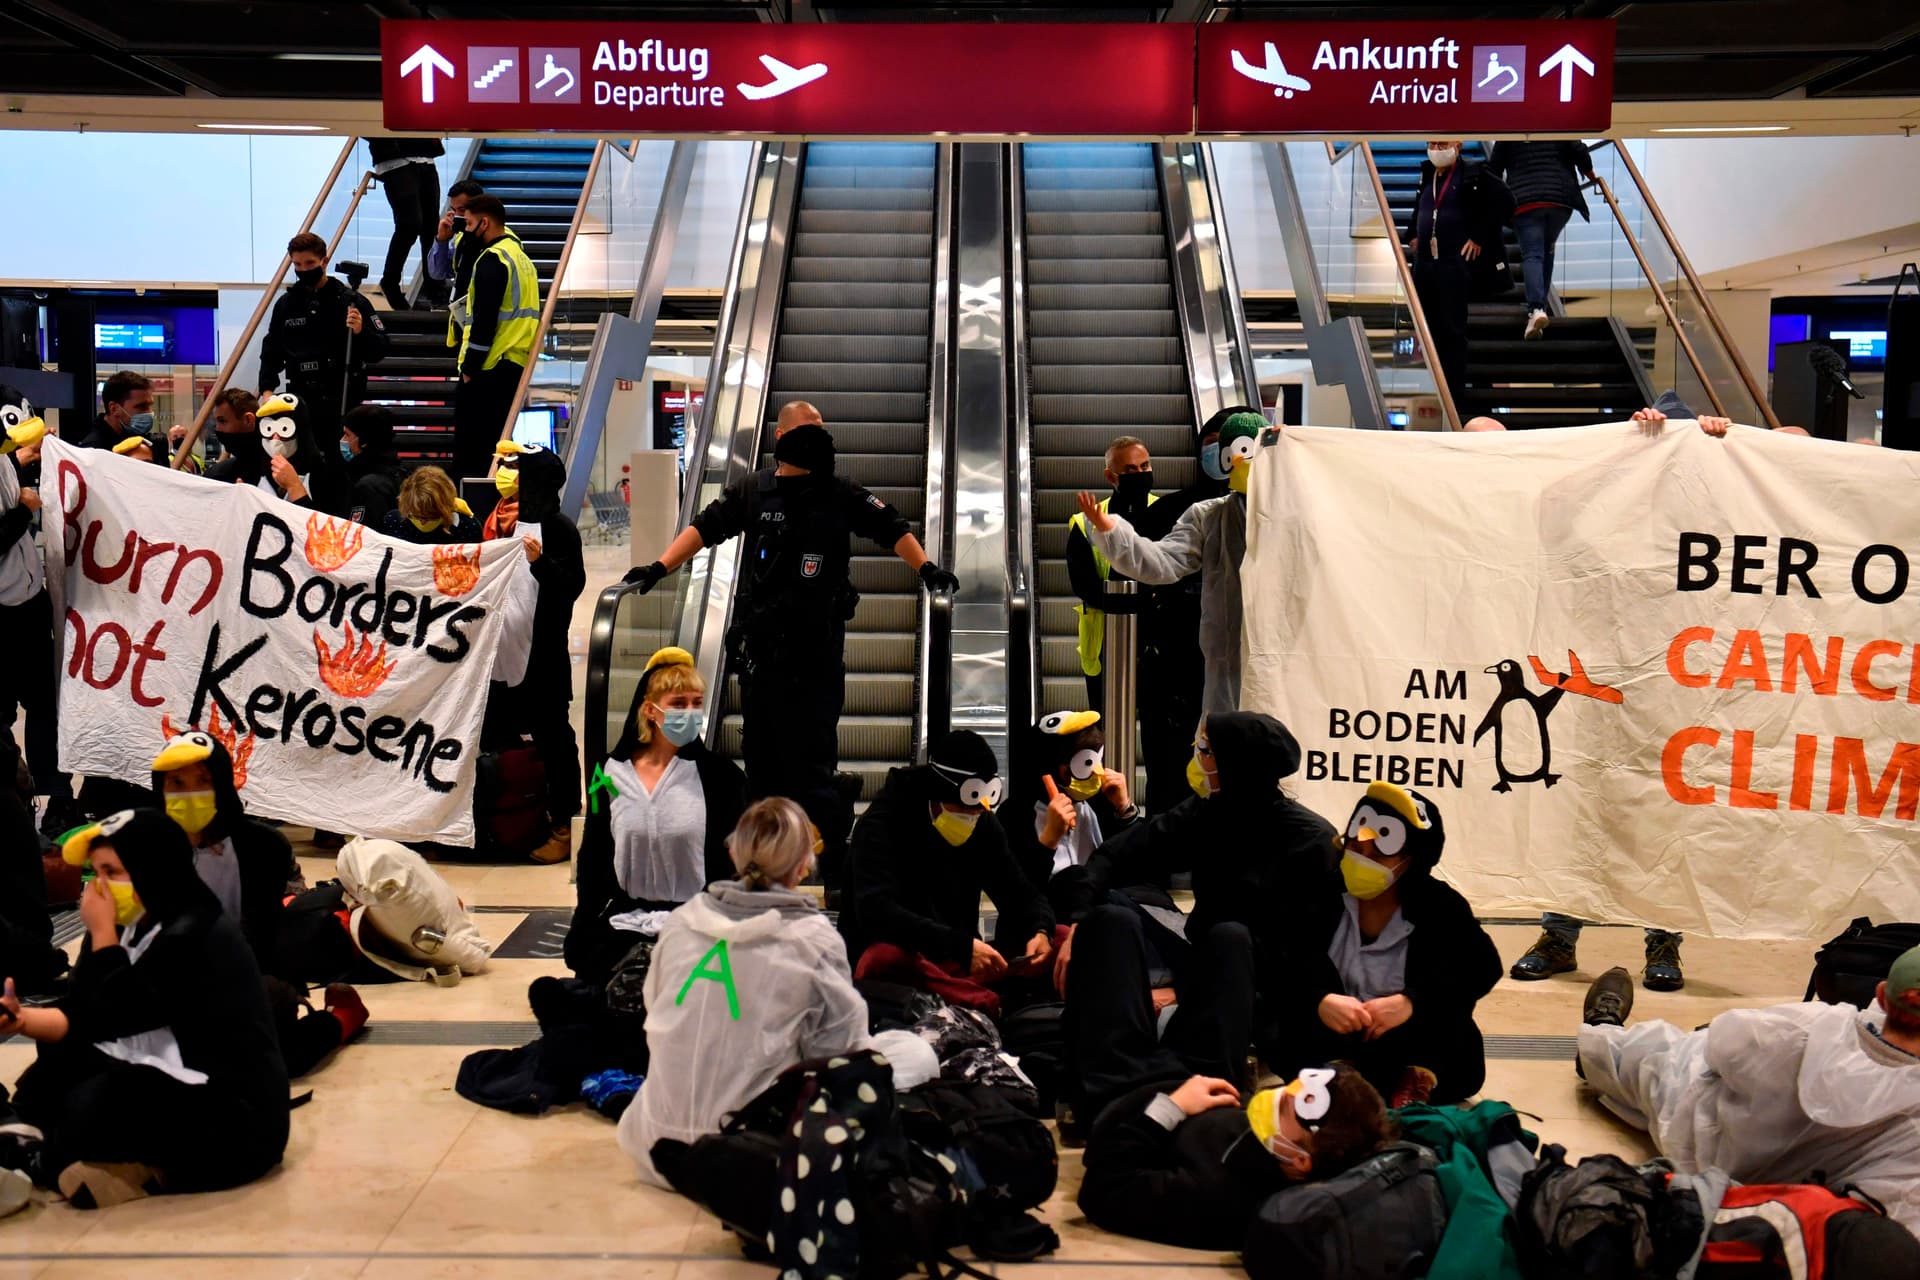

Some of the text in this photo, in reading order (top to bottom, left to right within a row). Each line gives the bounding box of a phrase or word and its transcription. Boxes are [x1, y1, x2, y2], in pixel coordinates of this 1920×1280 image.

[592, 39, 709, 81] Abflug
[1311, 37, 1460, 71] Ankunft
[594, 80, 726, 112] Departure
[1369, 78, 1459, 105] Arrival
[58, 459, 224, 617] Burn
[240, 512, 487, 663] Borders
[1676, 532, 1910, 604] BER O
[187, 620, 463, 793] Kerosene
[1403, 668, 1467, 700] AM
[1329, 707, 1466, 745] BODEN
[588, 761, 620, 814] A
[1306, 750, 1464, 789] BLEIBEN
[1661, 726, 1920, 822] CLIM
[675, 938, 742, 1021] A
